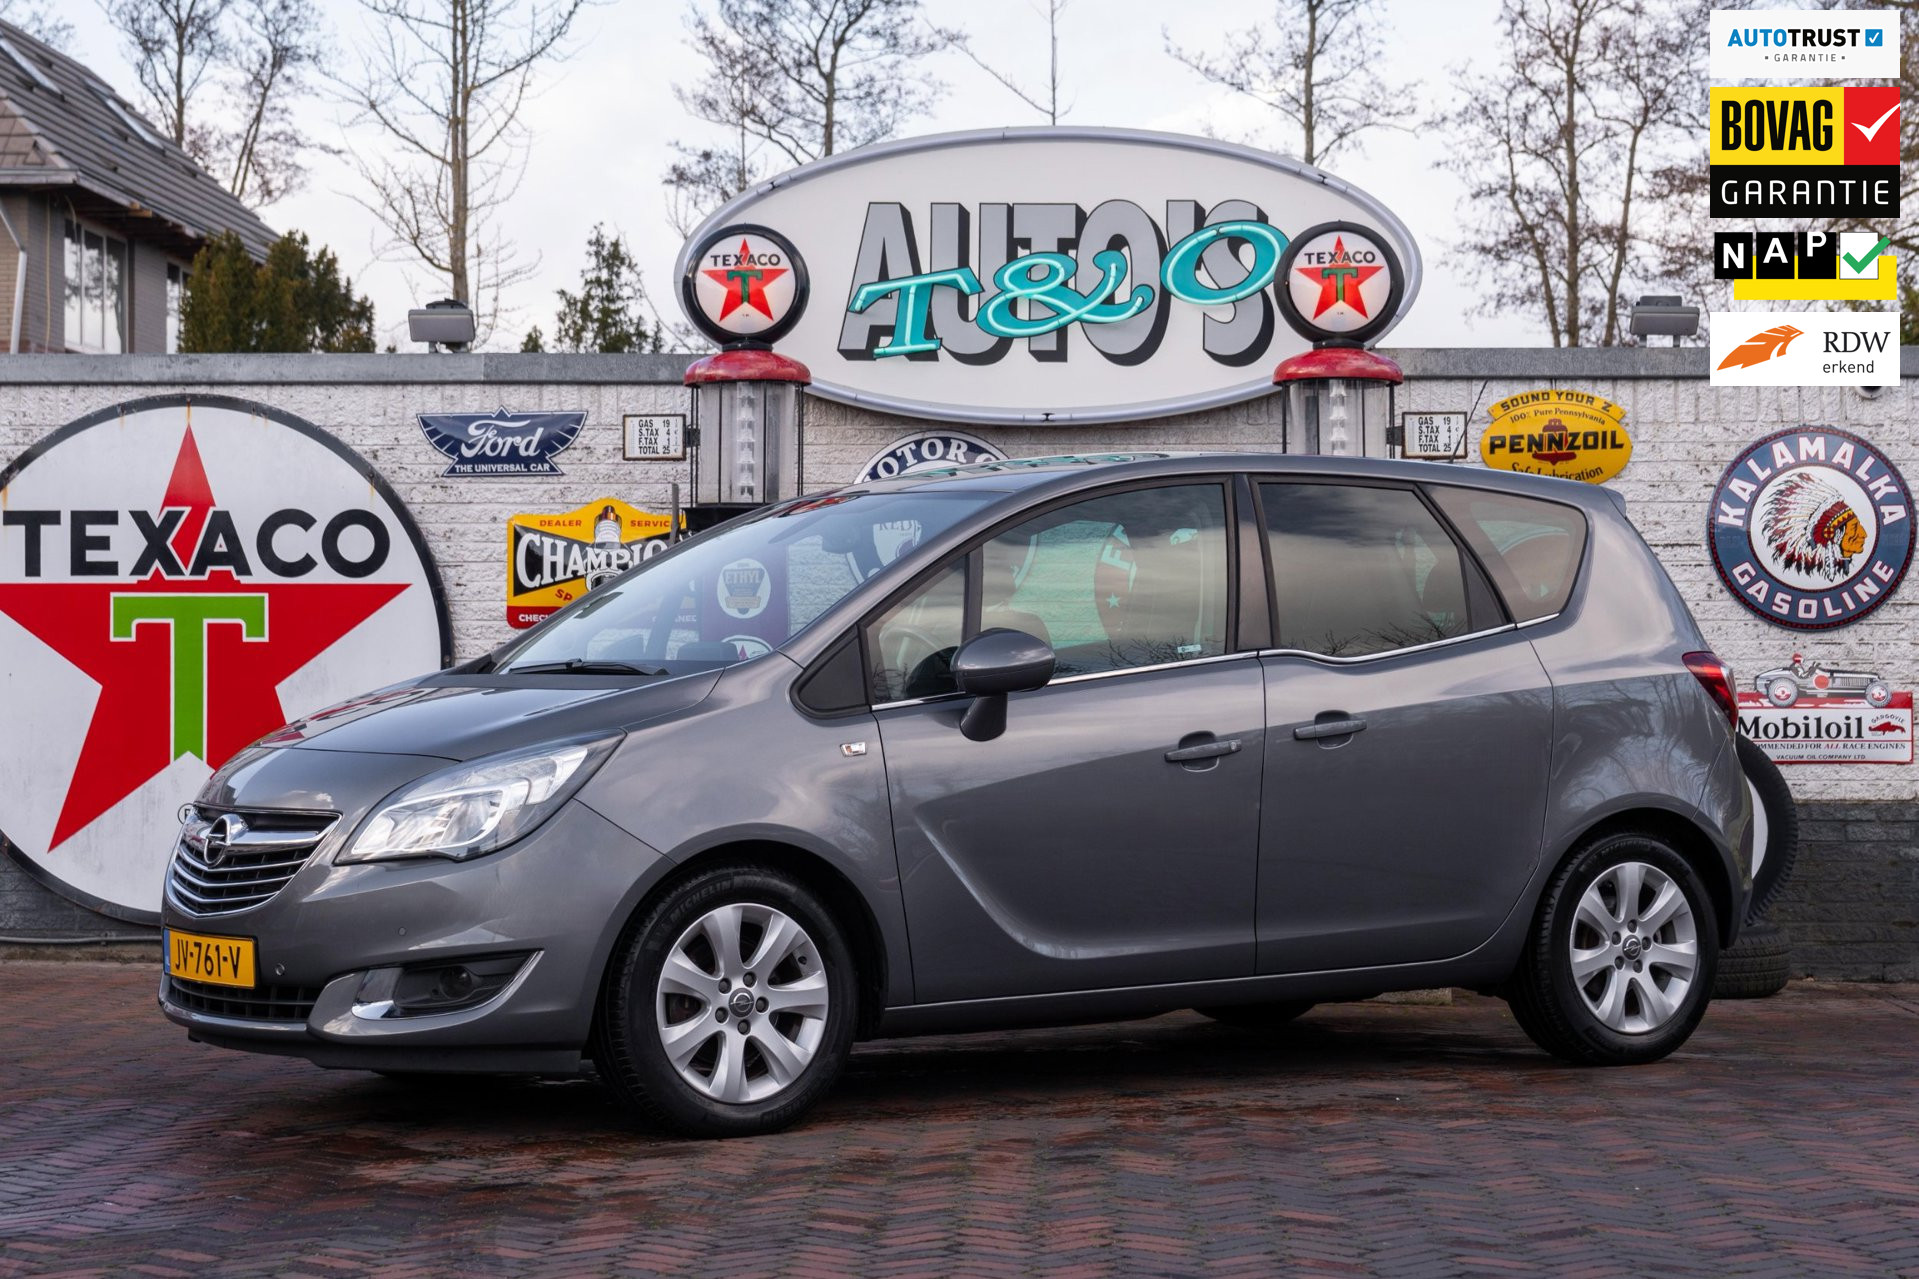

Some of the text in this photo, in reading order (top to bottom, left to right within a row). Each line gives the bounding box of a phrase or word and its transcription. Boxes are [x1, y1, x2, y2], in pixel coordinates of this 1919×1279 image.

[710, 253, 781, 267] TEXACO
[1304, 251, 1376, 265] TEXACO
[726, 270, 763, 304] T
[838, 199, 1269, 367] AUTO'S
[848, 219, 1290, 358] T & O
[1321, 268, 1358, 302] T
[1500, 391, 1613, 413] SOUND YOUR Z
[638, 419, 670, 428] GAS 19
[1418, 416, 1451, 425] GAS 19
[1533, 409, 1553, 417] Pure
[1554, 407, 1606, 426] Pennsylvania
[461, 419, 545, 457] Ford
[638, 428, 671, 437] S.TAX 4
[1418, 425, 1440, 434] S.TAX
[1418, 434, 1439, 443] F.TAX
[638, 437, 658, 446] F.TAX
[638, 445, 670, 455] TOTAL 25
[1418, 443, 1451, 453] TOTAL 25
[1489, 430, 1624, 455] PENNZOIL
[455, 463, 551, 473] THE UNIVERSAL CAR
[864, 438, 968, 482] OTOR
[1717, 436, 1907, 526] KALAMALKA
[539, 519, 582, 527] DEALER
[3, 508, 391, 578] TEXACO
[516, 532, 693, 588] CHAMPIO
[1731, 560, 1895, 619] GASOLINE
[111, 593, 269, 763] T
[1738, 715, 1864, 739] Mobiloil
[175, 939, 241, 979] JV-761-V
